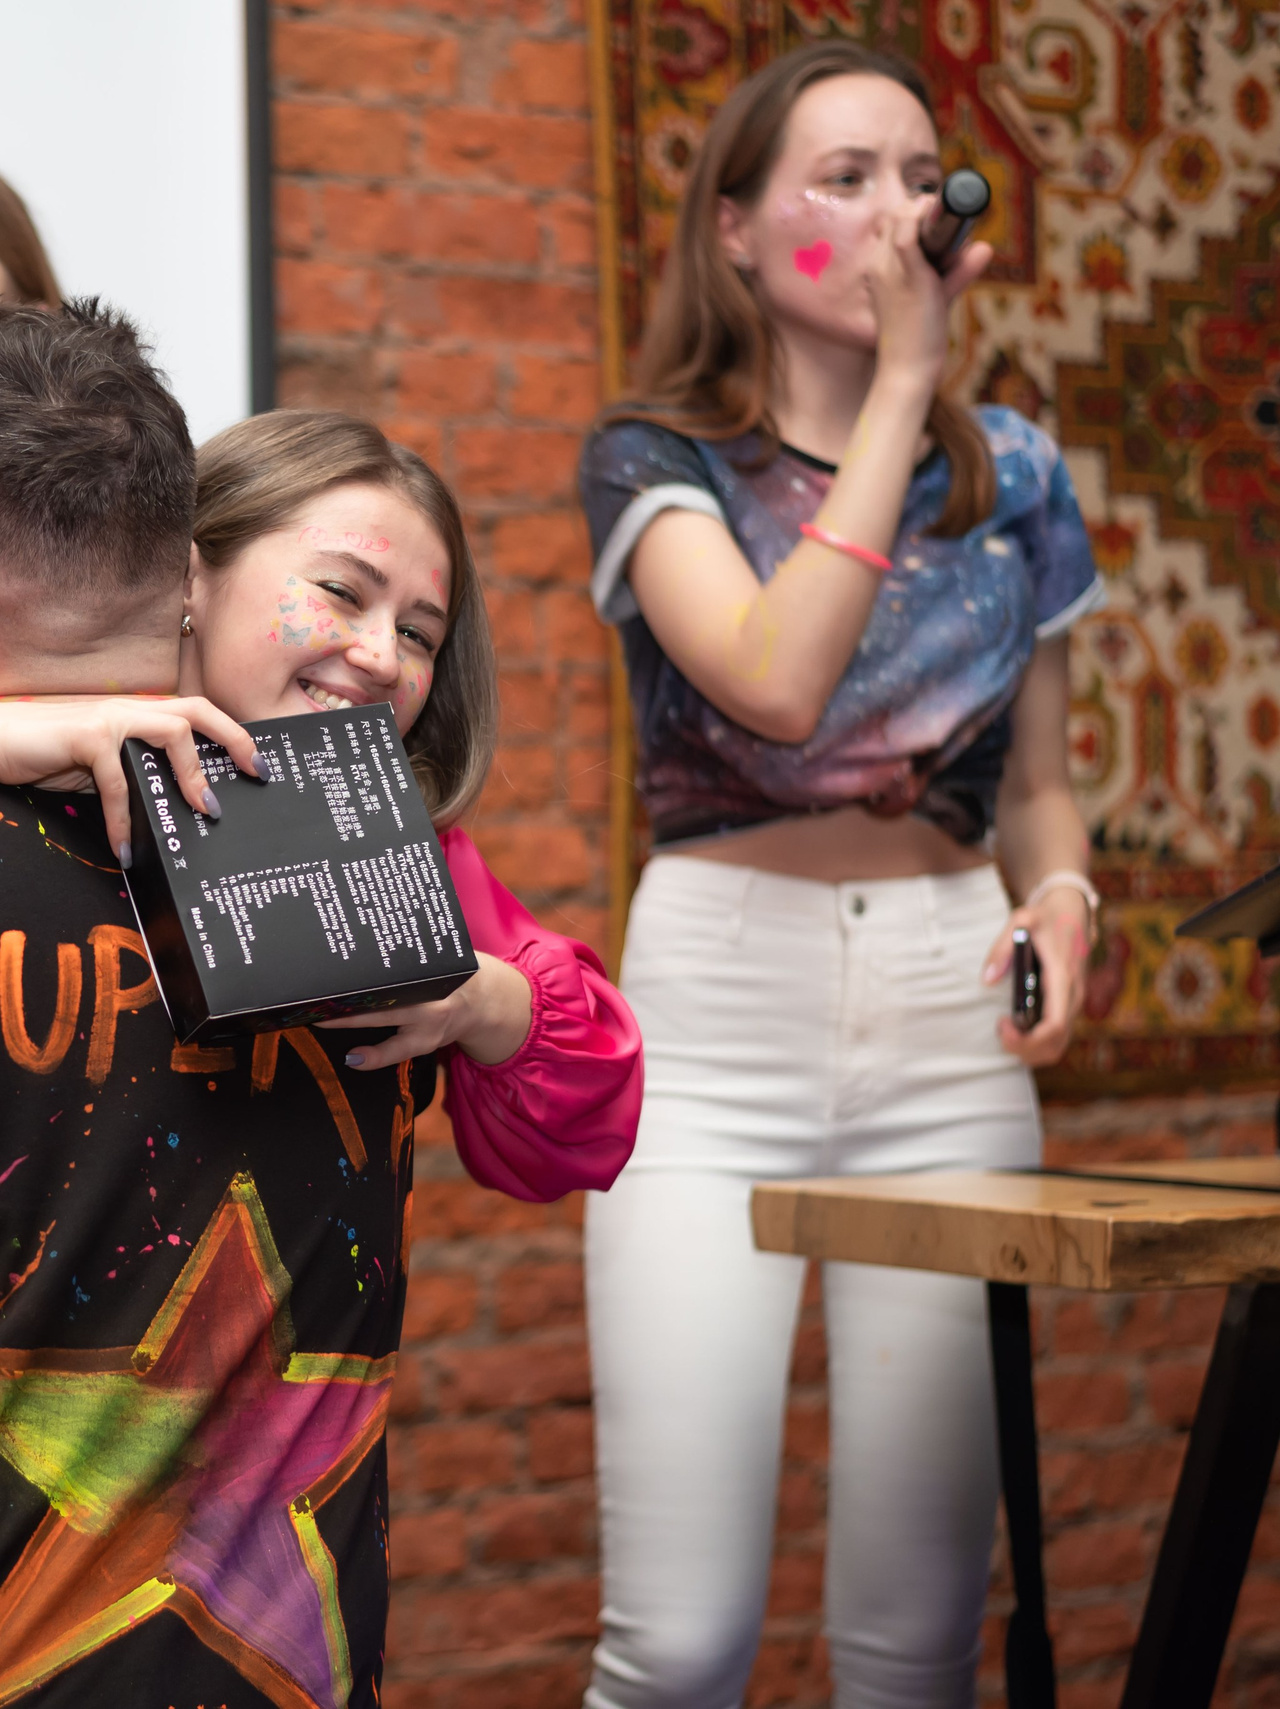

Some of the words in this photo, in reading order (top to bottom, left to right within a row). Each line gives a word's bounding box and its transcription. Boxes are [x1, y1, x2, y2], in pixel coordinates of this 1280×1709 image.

[255, 735, 263, 743] 2.
[264, 734, 271, 742] 1.
[268, 748, 285, 781] 七彩轮闪
[154, 798, 176, 833] RoHS
[320, 858, 329, 872] The
[350, 860, 362, 879] Work
[359, 859, 372, 881] button
[378, 856, 386, 866] for
[384, 847, 399, 874] Product
[218, 876, 227, 887] 11.
[228, 875, 237, 885] 10.
[292, 863, 300, 871] 3.
[296, 874, 307, 888] Red
[325, 872, 336, 889] work
[368, 857, 385, 891] insulation
[381, 866, 390, 878] the
[412, 843, 422, 859] size:
[418, 859, 430, 883] 165mm
[428, 888, 440, 912] 160mm
[200, 879, 209, 890] 12.
[240, 883, 252, 903] White
[249, 882, 258, 893] Ice
[259, 880, 271, 903] Yellow
[268, 879, 279, 895] Pink
[277, 877, 287, 893] Blue
[287, 876, 298, 897] Green
[315, 871, 330, 899] Colorful
[357, 880, 369, 904] status,
[367, 881, 374, 889] to
[385, 878, 396, 892] first
[203, 890, 213, 901] Off
[231, 885, 242, 905] White
[253, 893, 263, 908] blue
[342, 868, 357, 896] seconds
[352, 896, 360, 904] to
[356, 906, 367, 924] close
[370, 889, 381, 906] start
[380, 891, 392, 912] sheet,
[390, 892, 400, 910] time,
[392, 874, 412, 915] Description:
[403, 844, 415, 865] Usage
[410, 866, 427, 902] occasions:
[423, 903, 437, 935] concerts,
[433, 935, 443, 953] bars,
[411, 898, 420, 909] etc
[421, 841, 436, 868] Product
[430, 868, 442, 889] Name:
[438, 889, 455, 928] Technology
[450, 929, 463, 957] Glasses
[215, 895, 226, 914] turns
[221, 887, 243, 935] red/green/blue
[237, 905, 249, 922] light
[305, 873, 321, 900] Colorful
[313, 900, 330, 929] gradient
[325, 931, 337, 953] colors
[330, 889, 346, 922] sequence
[190, 906, 204, 929] Made
[325, 902, 339, 930] flashing
[364, 908, 377, 927] press
[375, 906, 389, 934] emitting
[385, 913, 398, 932] press
[394, 910, 407, 924] pull
[405, 915, 419, 935] When
[198, 932, 207, 941] in
[244, 923, 255, 941] flash
[335, 931, 342, 939] in
[341, 922, 353, 941] mode
[372, 927, 383, 941] and
[394, 932, 402, 944] the
[400, 924, 410, 936] out
[238, 935, 252, 964] flashing
[338, 941, 349, 960] turns
[348, 941, 356, 951] is:
[377, 941, 388, 957] hold
[384, 934, 396, 951] light
[404, 936, 413, 947] the
[411, 935, 427, 963] wearing
[202, 943, 216, 968] China
[382, 957, 390, 967] for
